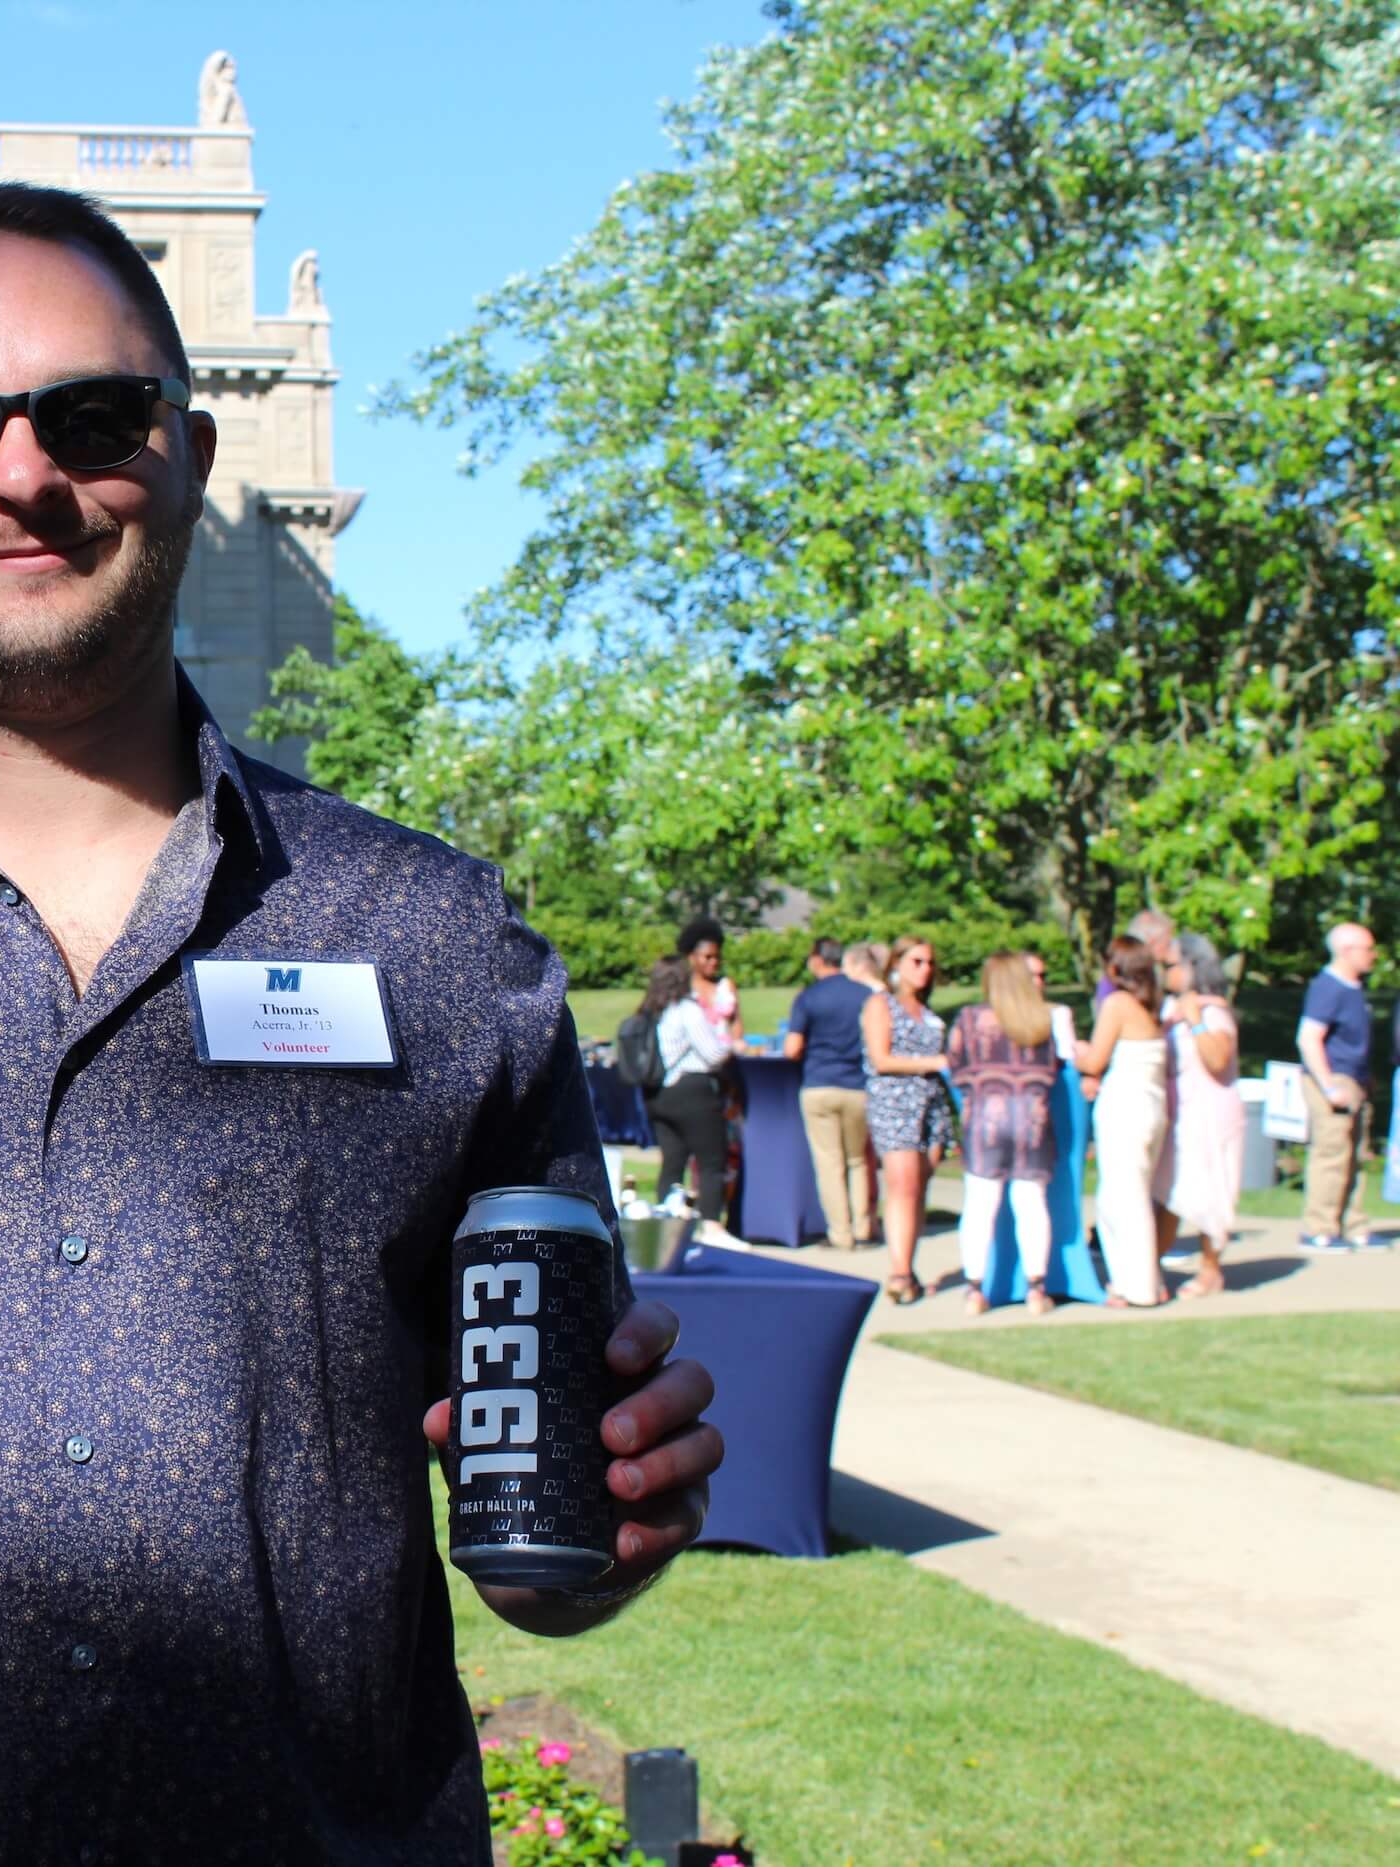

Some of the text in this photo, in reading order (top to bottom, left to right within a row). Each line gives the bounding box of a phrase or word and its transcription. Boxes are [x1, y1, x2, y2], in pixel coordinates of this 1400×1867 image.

[265, 968, 302, 992] M
[259, 1004, 320, 1016] Thomas
[252, 1020, 295, 1031] Acerra,
[299, 1020, 313, 1031] Jr.
[262, 1041, 330, 1054] Volunteer
[460, 1262, 539, 1485] 1933
[460, 1499, 536, 1515] GREAT HALL IPA
